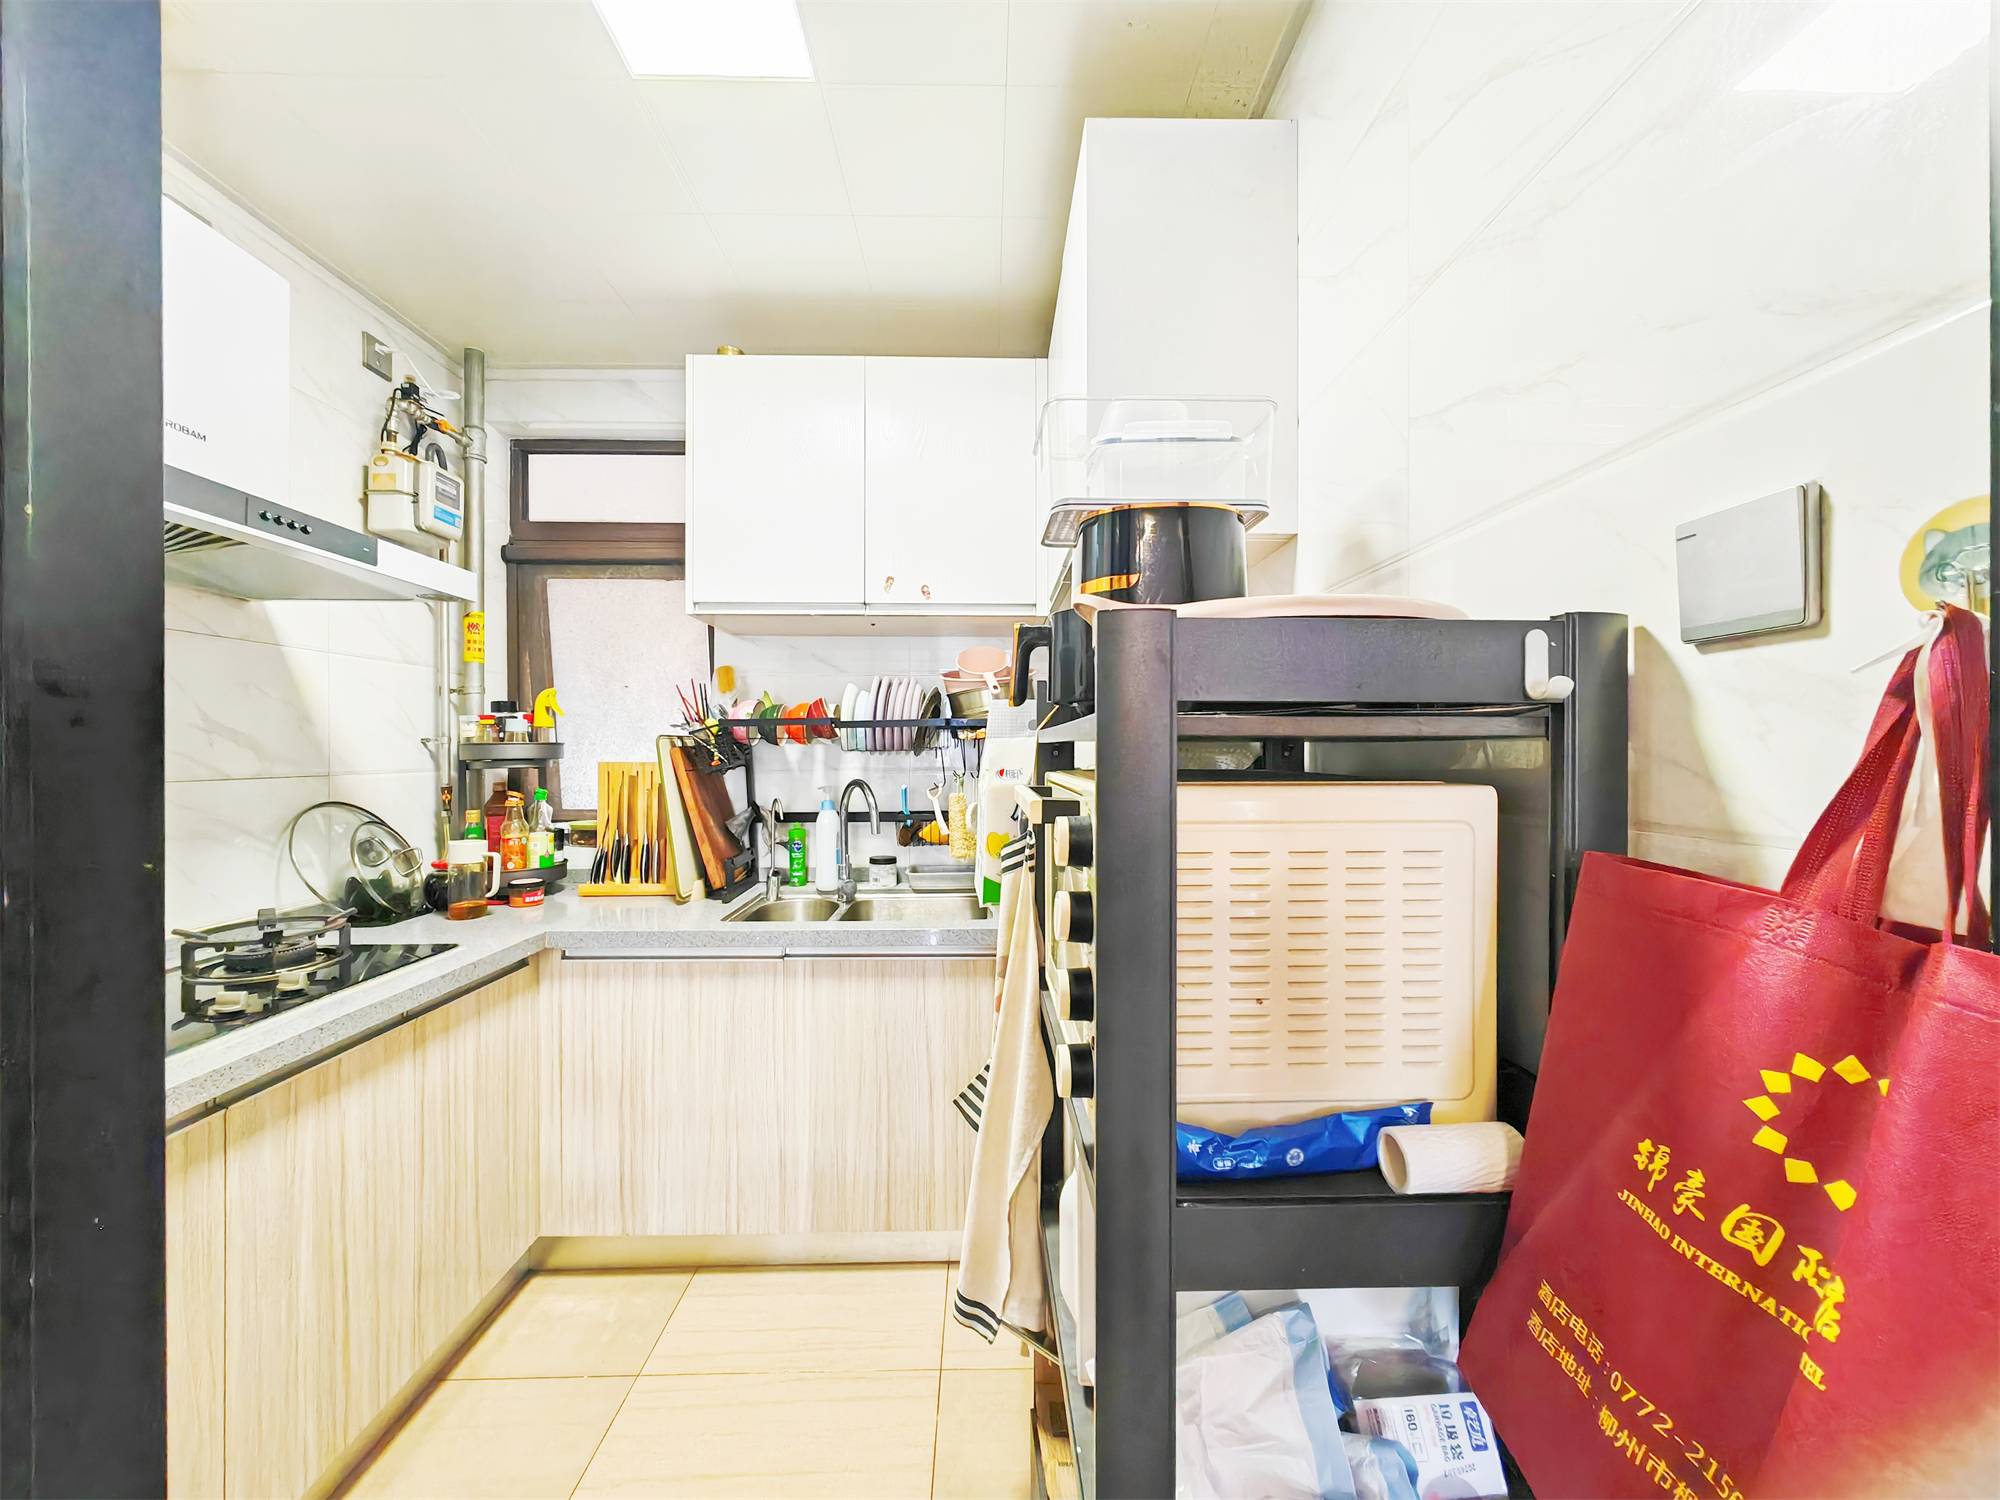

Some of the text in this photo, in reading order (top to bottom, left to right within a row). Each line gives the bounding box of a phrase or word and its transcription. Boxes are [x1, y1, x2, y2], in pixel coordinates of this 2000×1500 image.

[165, 419, 206, 442] ROBAM
[1617, 1189, 1671, 1241] JINHAO
[1404, 1409, 1418, 1431] 160
